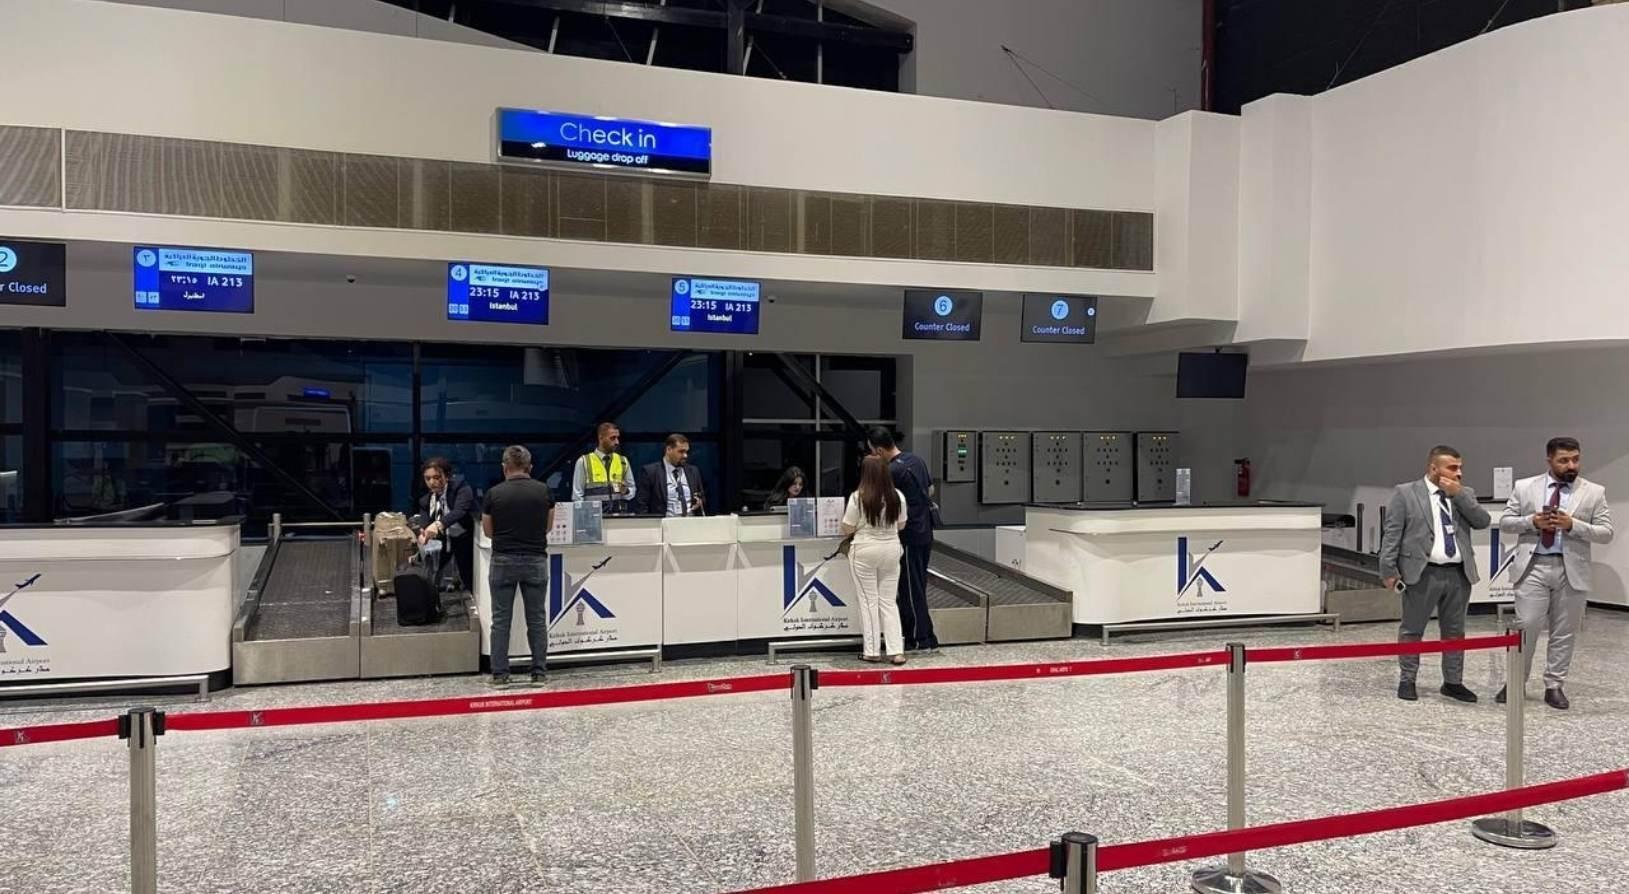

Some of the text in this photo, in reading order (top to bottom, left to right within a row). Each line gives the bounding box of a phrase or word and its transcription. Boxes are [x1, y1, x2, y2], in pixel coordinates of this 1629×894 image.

[559, 122, 656, 149] Check in
[567, 149, 649, 165] Luggage drop off
[0, 251, 9, 267] 2
[455, 268, 462, 278] 4
[207, 276, 243, 287] IA 213
[8, 282, 47, 294] Closed
[679, 283, 685, 292] 5
[469, 287, 540, 301] 23:15 IA 213
[489, 302, 518, 311] Istanbul
[691, 300, 752, 312] 23:15 IA 213
[939, 300, 947, 312] 6
[1056, 304, 1064, 315] 7
[707, 314, 733, 322] Istanbul
[914, 322, 971, 332] Counter Closed
[1032, 325, 1085, 335] Counter Closed
